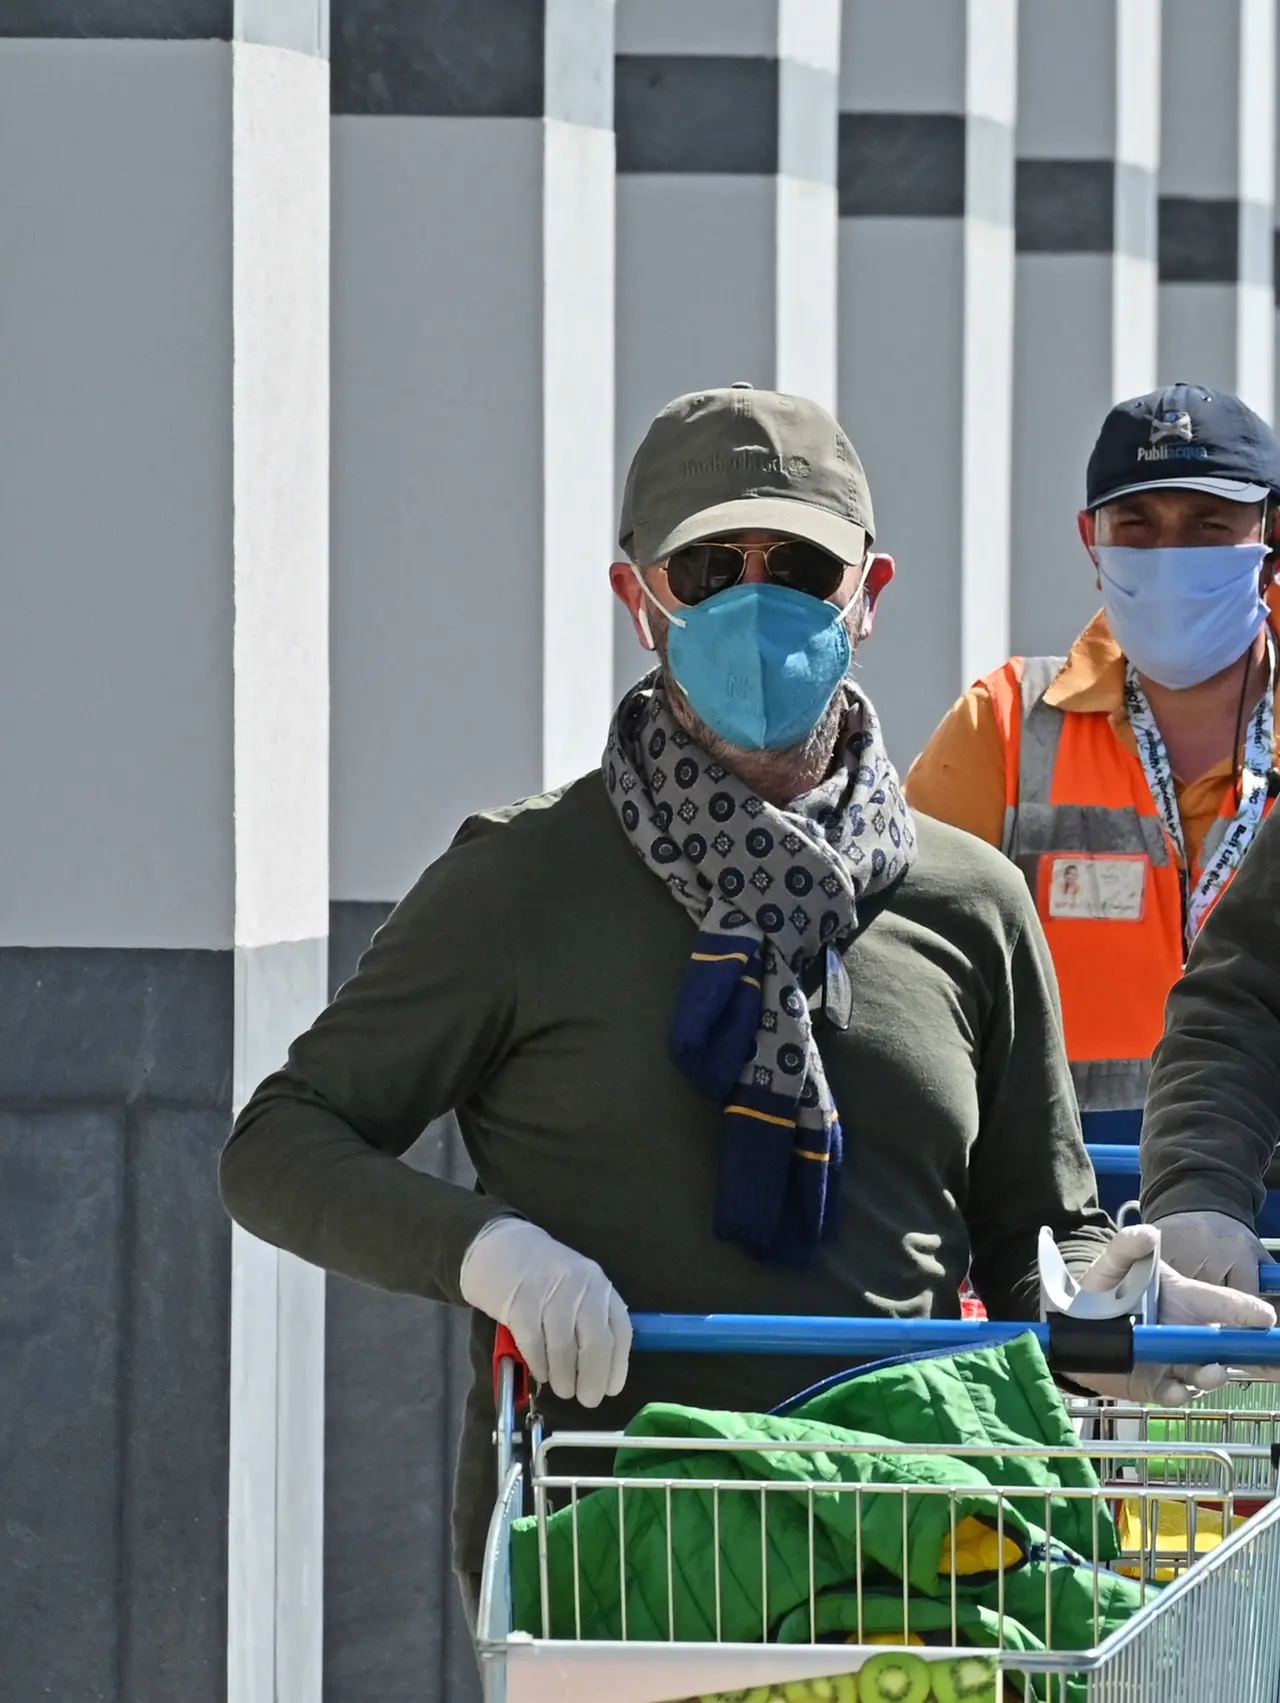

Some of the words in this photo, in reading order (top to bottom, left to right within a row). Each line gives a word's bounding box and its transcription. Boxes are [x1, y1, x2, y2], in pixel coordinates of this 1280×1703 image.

[1228, 824, 1247, 847] Best
[1216, 849, 1233, 869] Life
[1201, 870, 1220, 895] Ever
